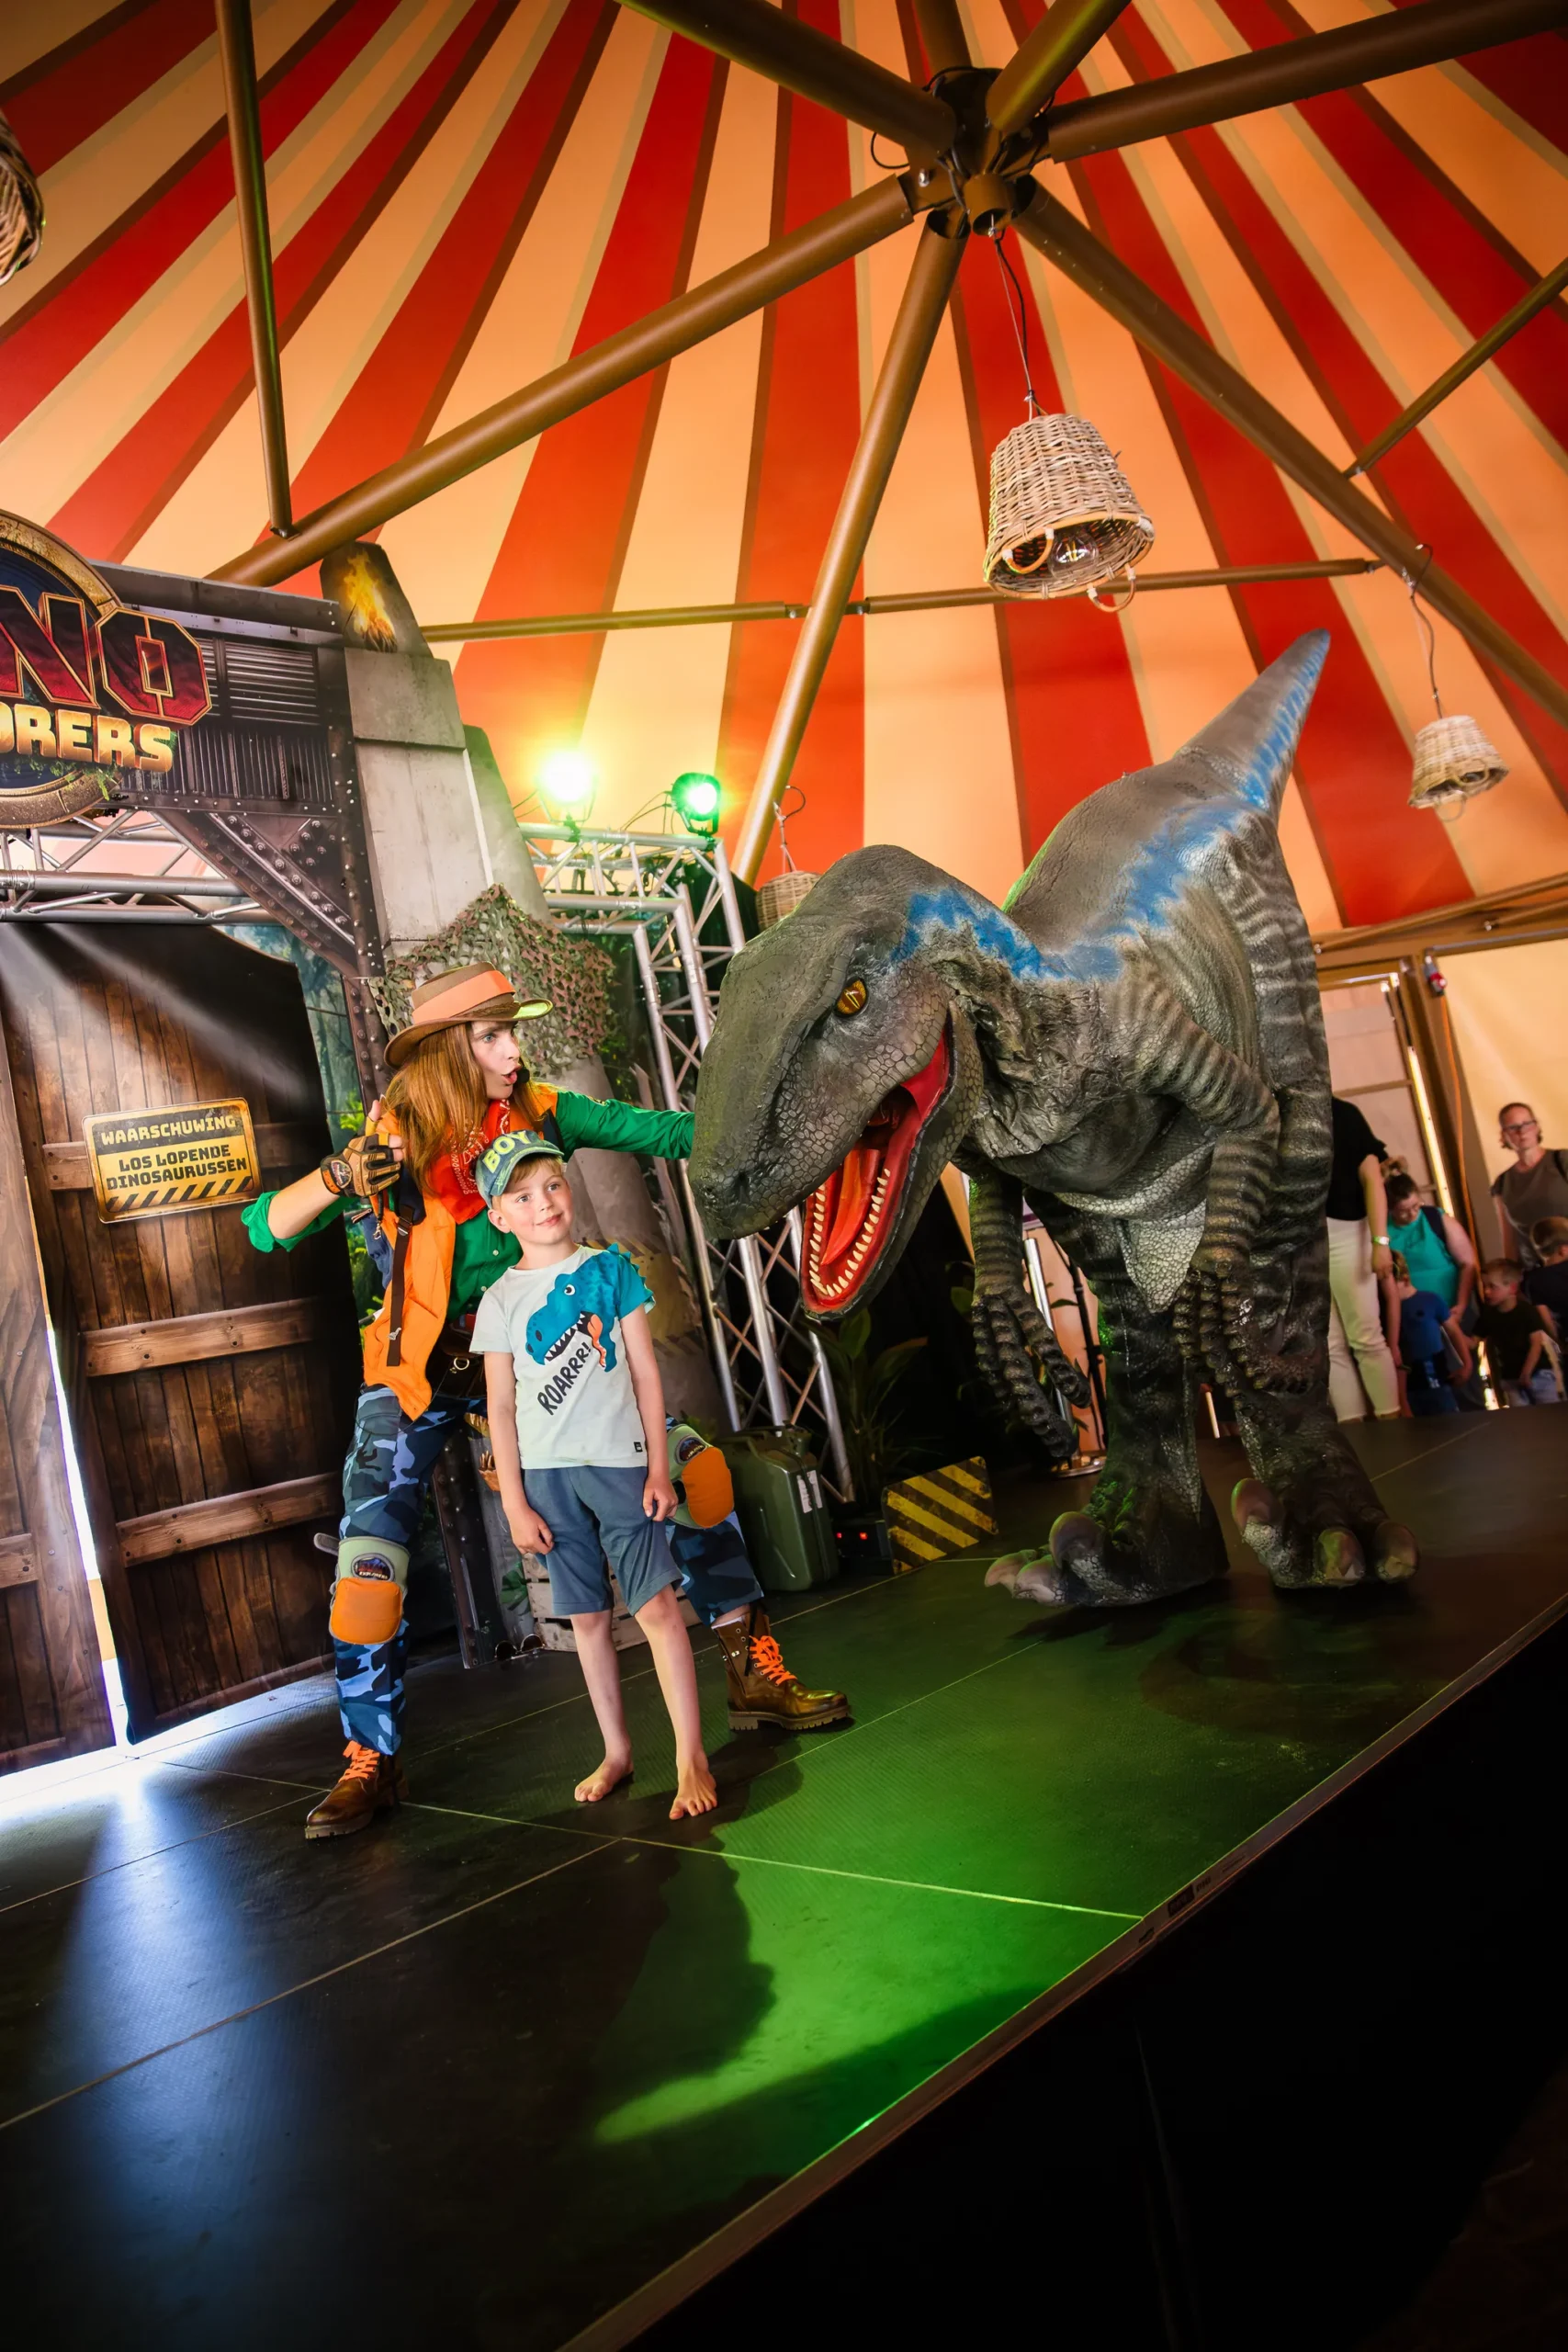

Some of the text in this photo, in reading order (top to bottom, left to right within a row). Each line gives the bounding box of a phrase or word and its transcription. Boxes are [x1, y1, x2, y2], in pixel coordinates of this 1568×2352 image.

[101, 1114, 236, 1146] WAARSCHUWING
[118, 1144, 231, 1172] LOS LOPENDE
[482, 1130, 531, 1173] BOY
[106, 1158, 247, 1191] DINOSAURUSSEN
[537, 1342, 591, 1416] ROARRR!
